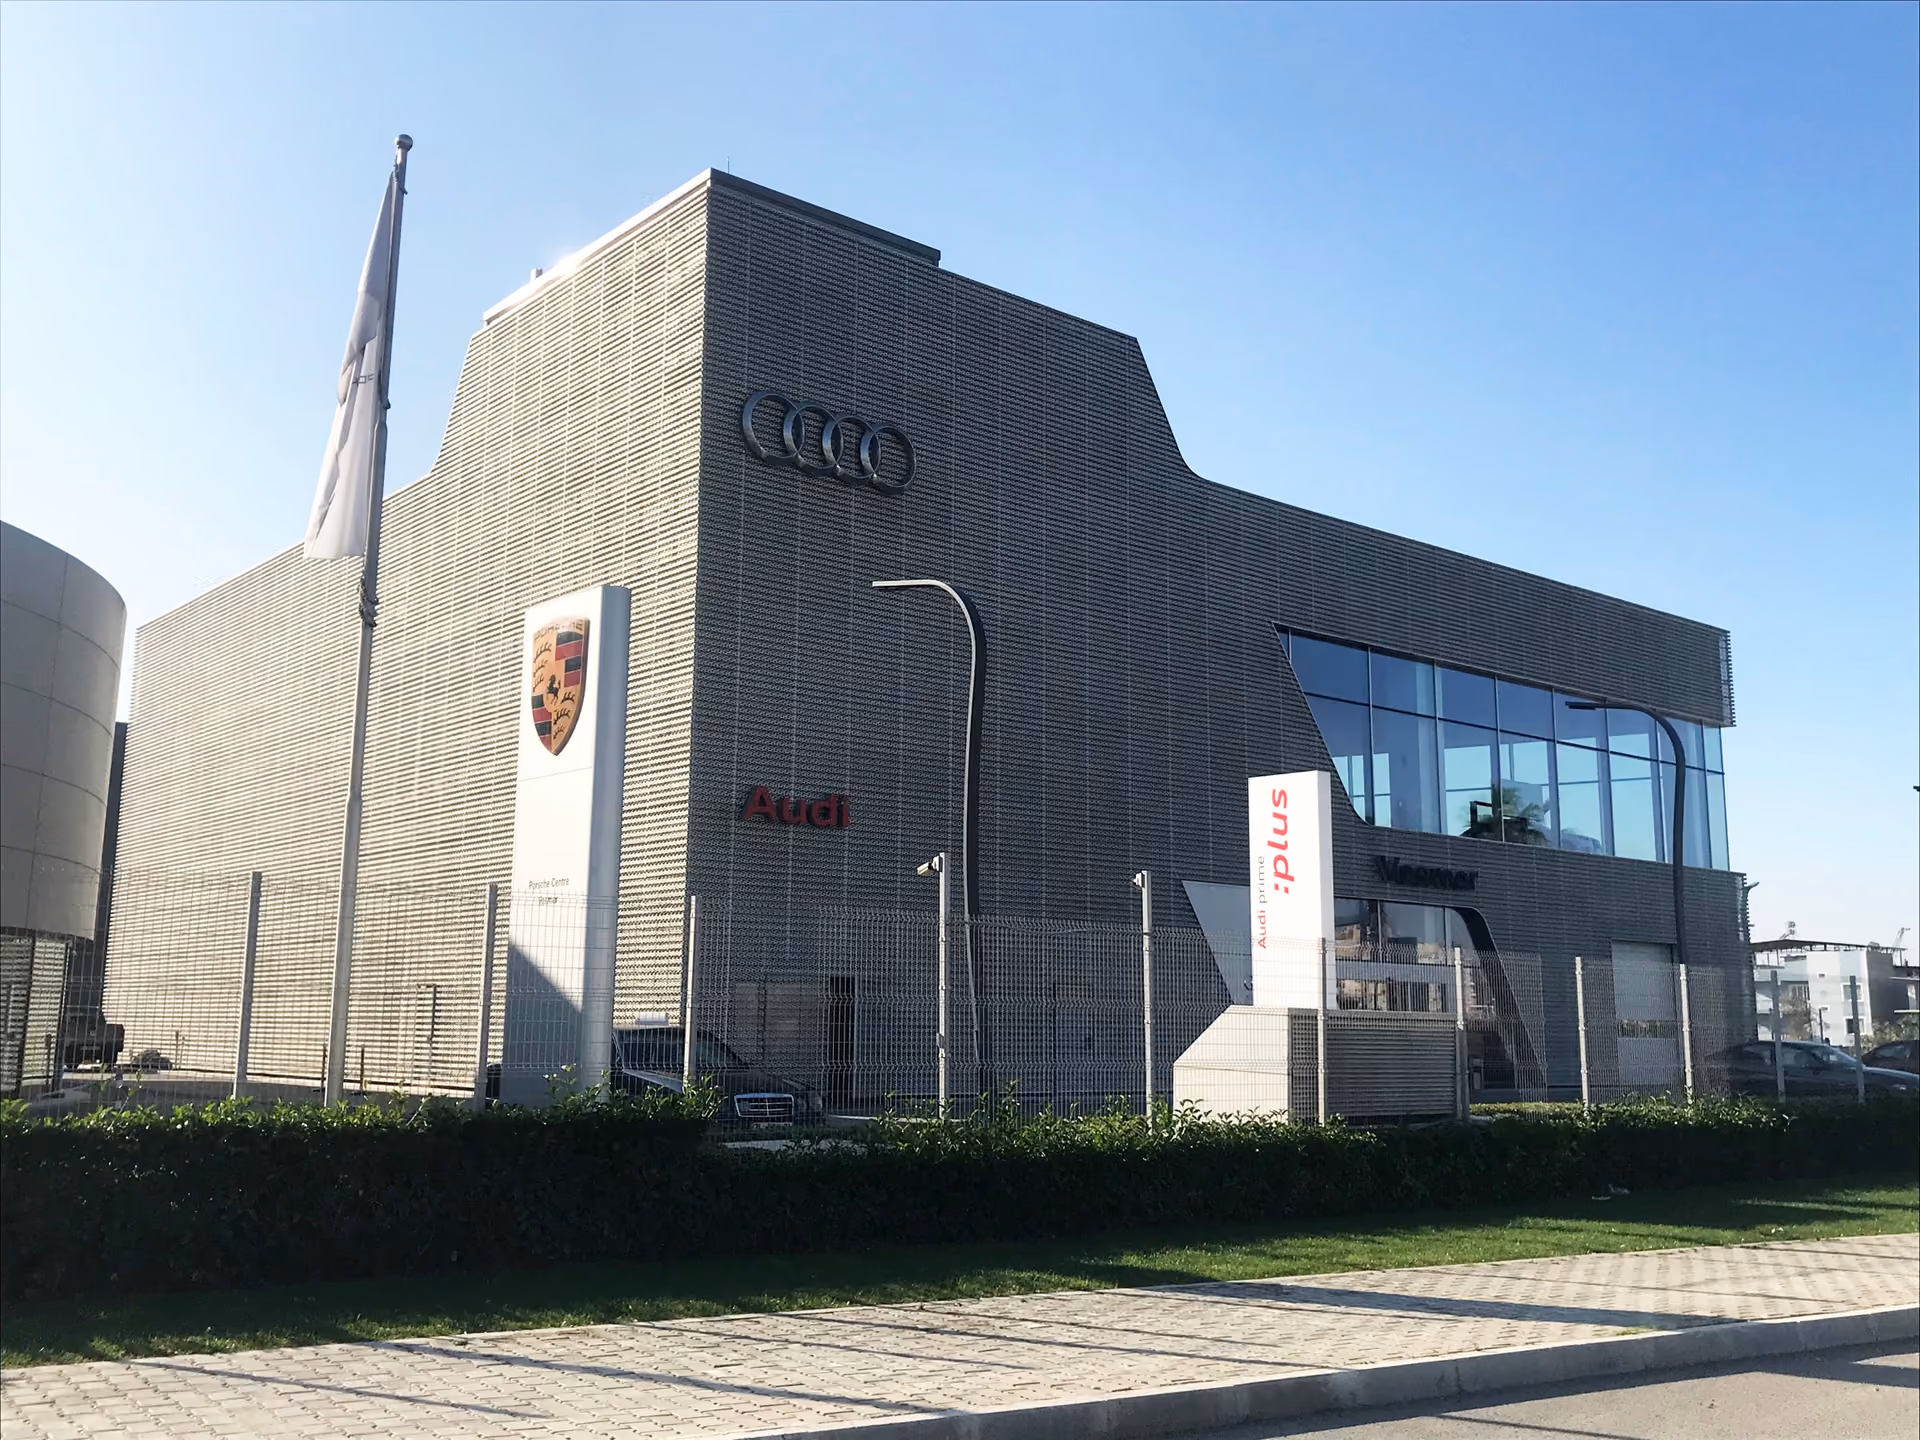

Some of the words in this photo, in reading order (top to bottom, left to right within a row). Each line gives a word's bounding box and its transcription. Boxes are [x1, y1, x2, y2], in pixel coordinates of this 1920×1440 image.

[742, 785, 849, 828] Audi
[1267, 788, 1295, 895] :plus
[528, 879, 550, 890] Porsche
[1257, 855, 1268, 904] prime
[1257, 909, 1266, 949] Audi
